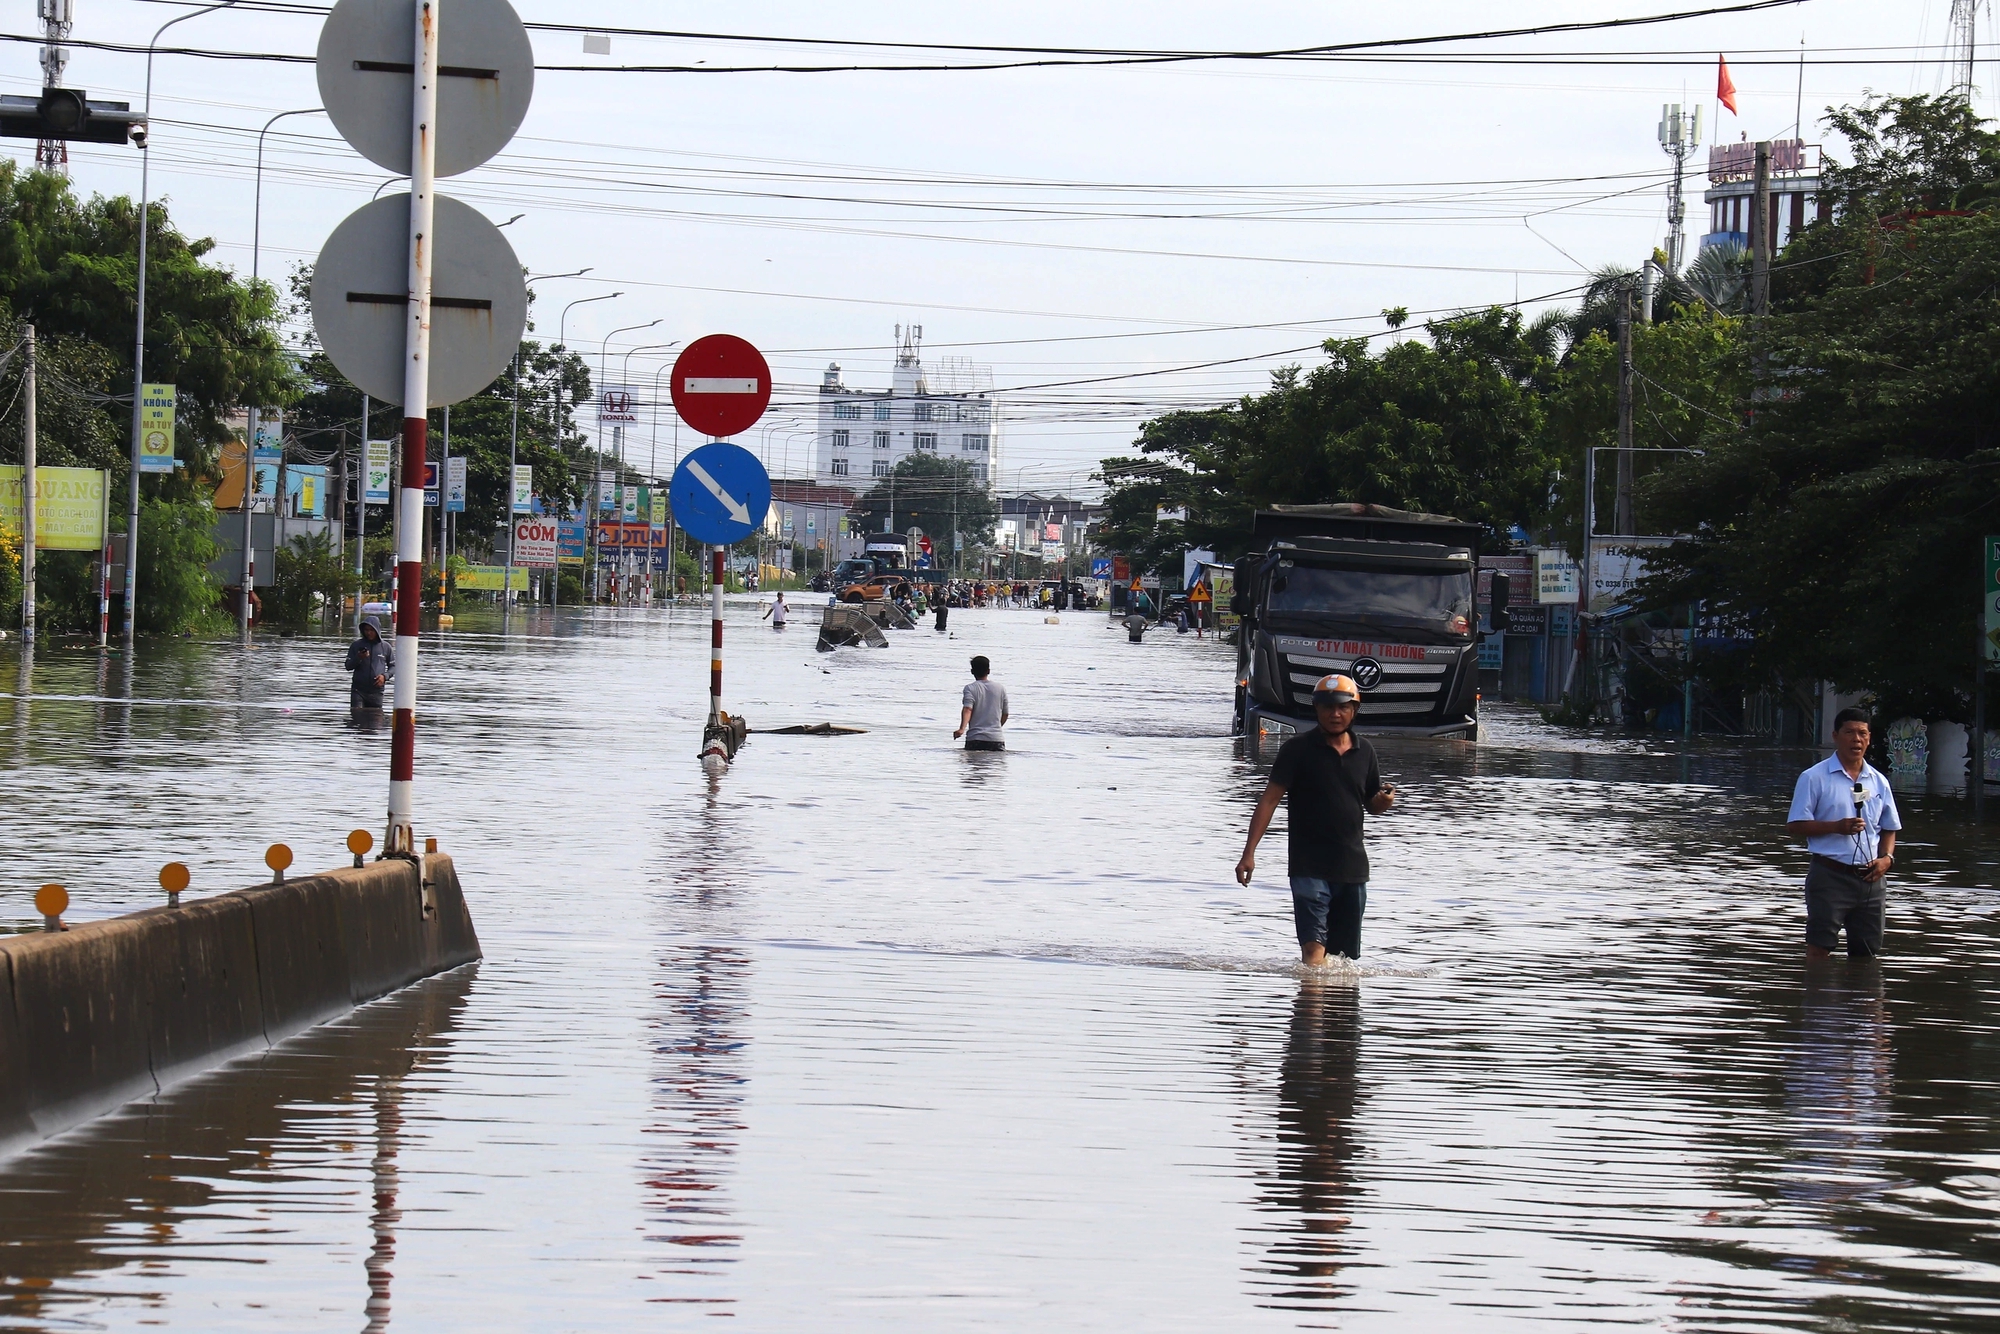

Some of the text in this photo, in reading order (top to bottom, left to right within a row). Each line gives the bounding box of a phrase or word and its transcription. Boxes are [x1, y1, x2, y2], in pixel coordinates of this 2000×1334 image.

[143, 397, 172, 407] KHÔNG
[517, 522, 556, 542] CƠM
[612, 529, 662, 544] JOTUN
[638, 553, 662, 564] UYỀN
[1343, 641, 1374, 657] NHẬT
[1378, 644, 1425, 660] TRƯỜNG
[1893, 738, 1924, 751] C2 C2 C2
[1989, 748, 2000, 759] C2
